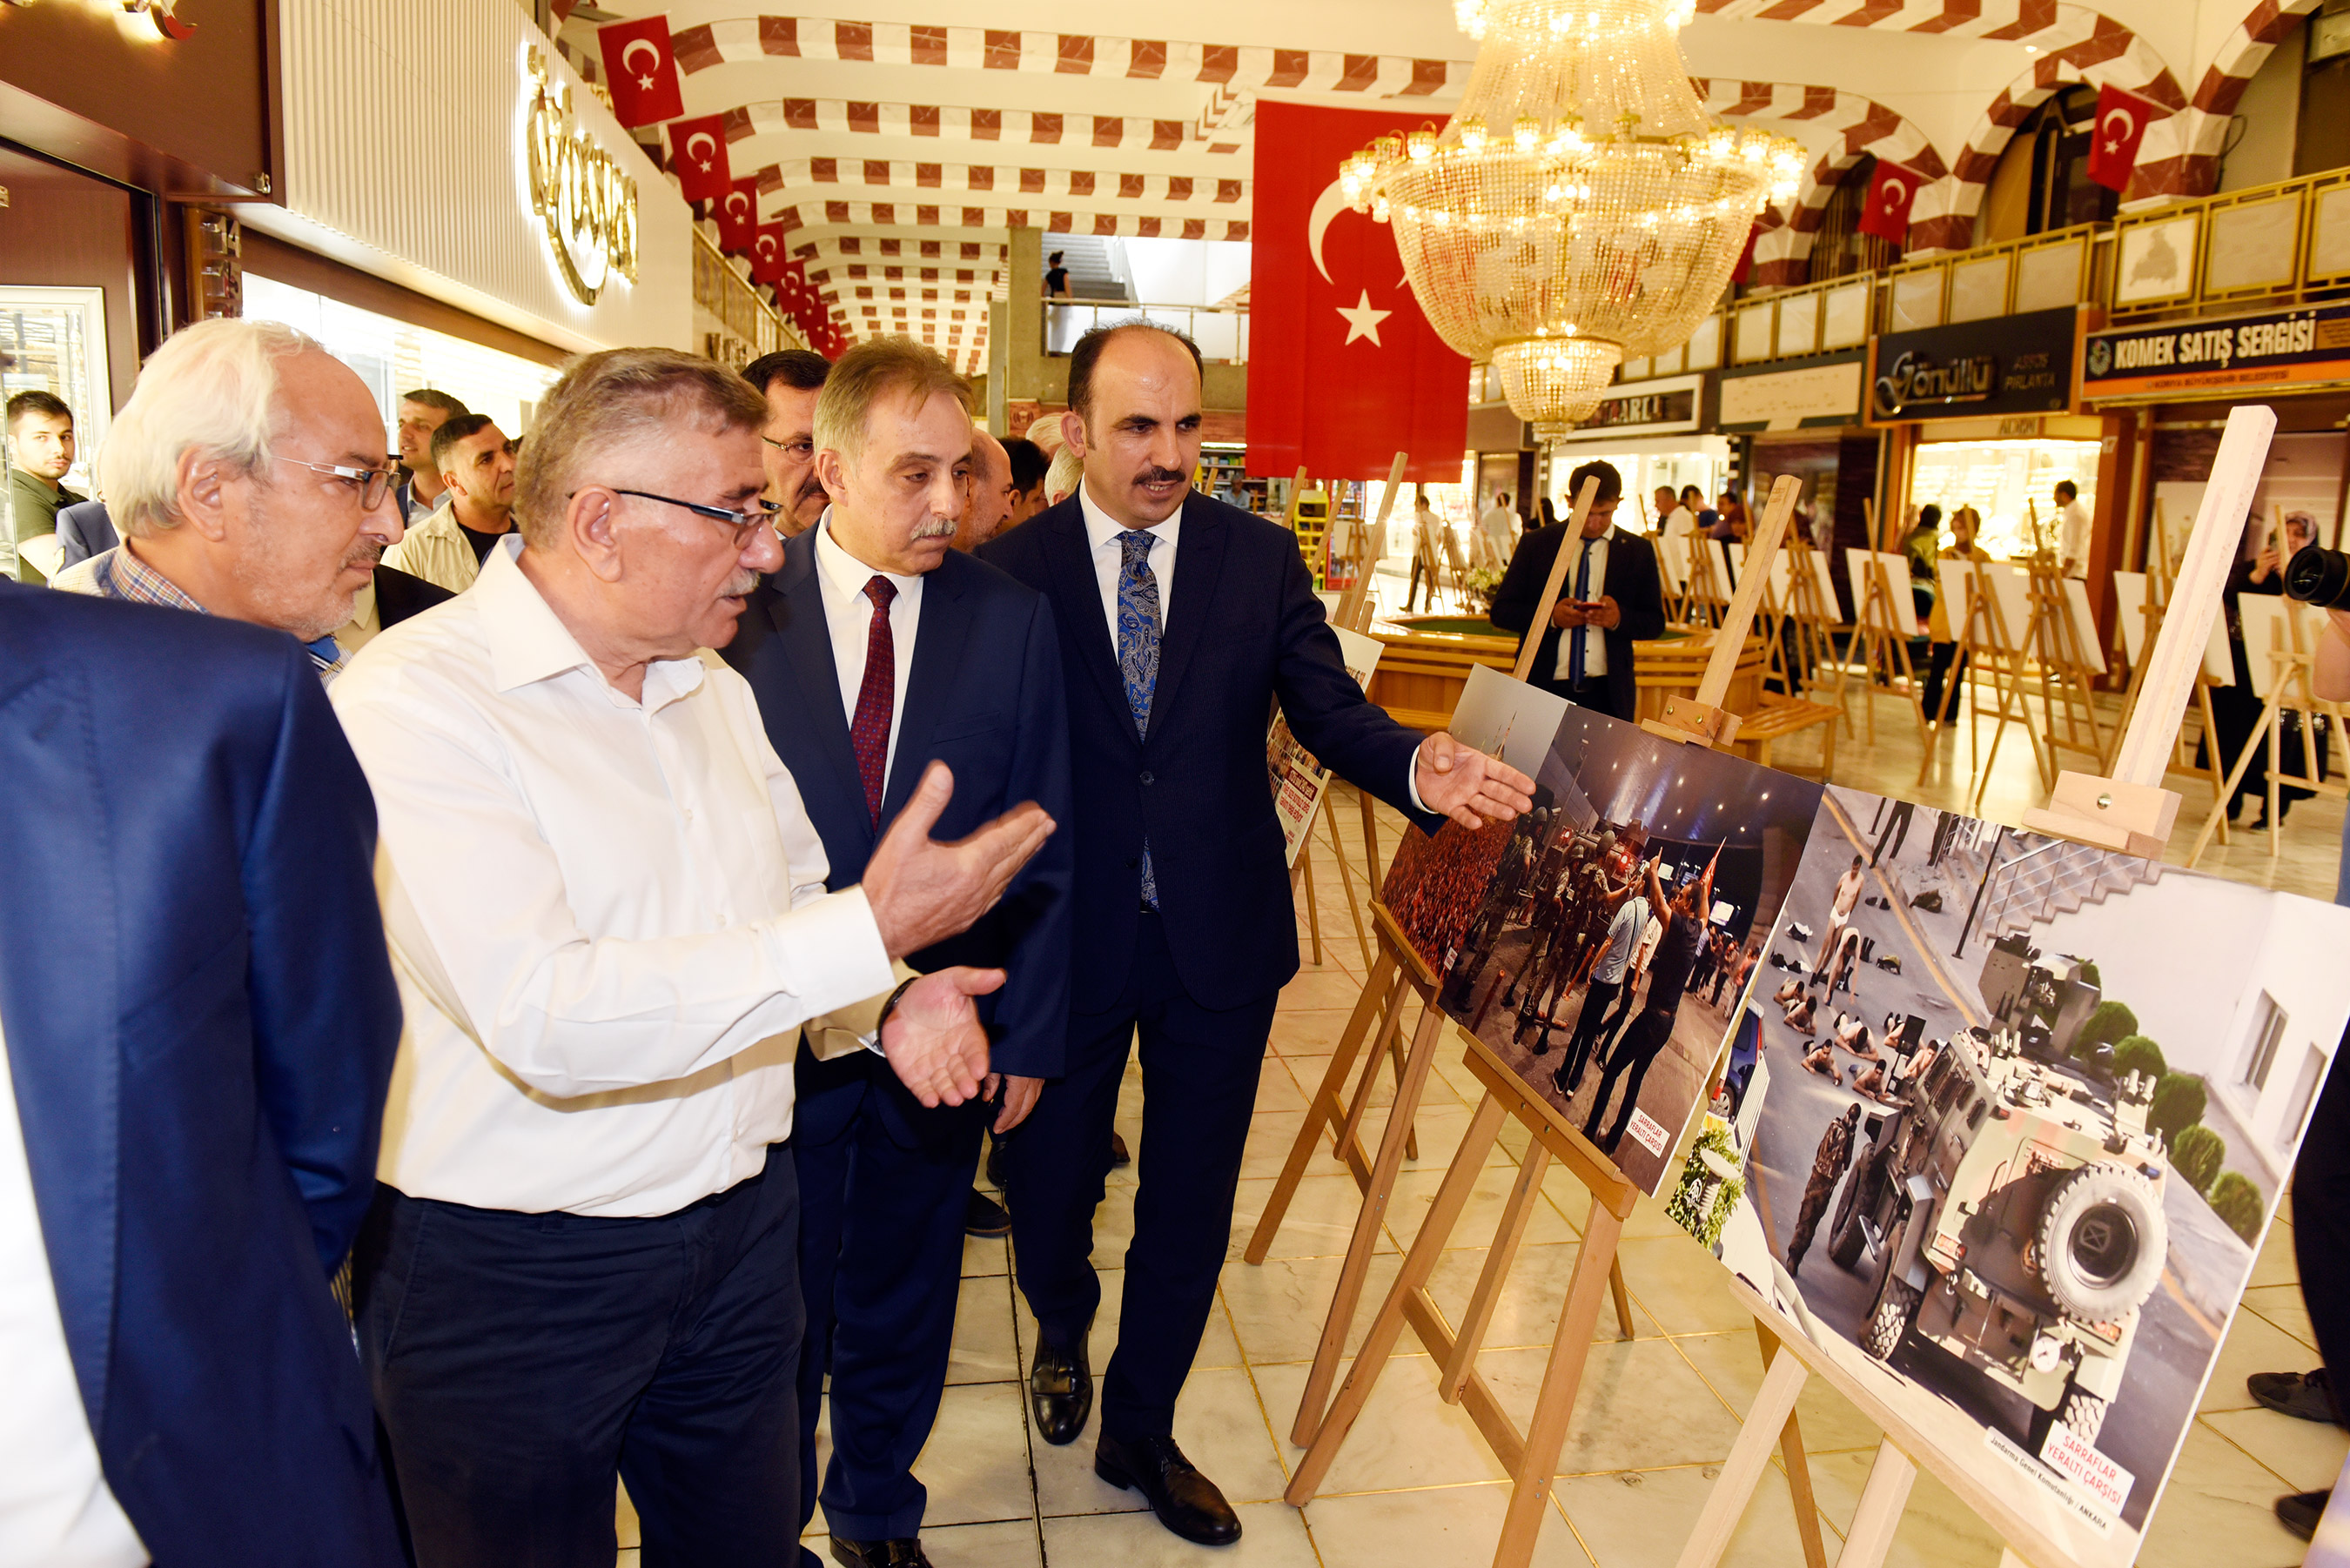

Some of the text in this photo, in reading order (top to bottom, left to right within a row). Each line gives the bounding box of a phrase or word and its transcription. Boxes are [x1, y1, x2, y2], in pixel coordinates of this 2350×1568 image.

[2115, 334, 2178, 370] KOMEK
[2179, 328, 2234, 369] SATIŞ
[2236, 310, 2318, 359] SERGİSİ
[1875, 351, 1996, 418] Gönüllü
[1629, 1120, 1662, 1153] YERALTI ÇARŞISI
[1637, 1114, 1662, 1139] SARRAFLAR
[1991, 1436, 2019, 1464] Jandarma
[2019, 1457, 2038, 1477] Genel
[2037, 1471, 2075, 1506] Komutanlığı
[2078, 1504, 2107, 1531] ANKARA
[2048, 1442, 2123, 1506] YERALTI ÇARŞISI
[2063, 1435, 2117, 1481] SARRAFLAR
